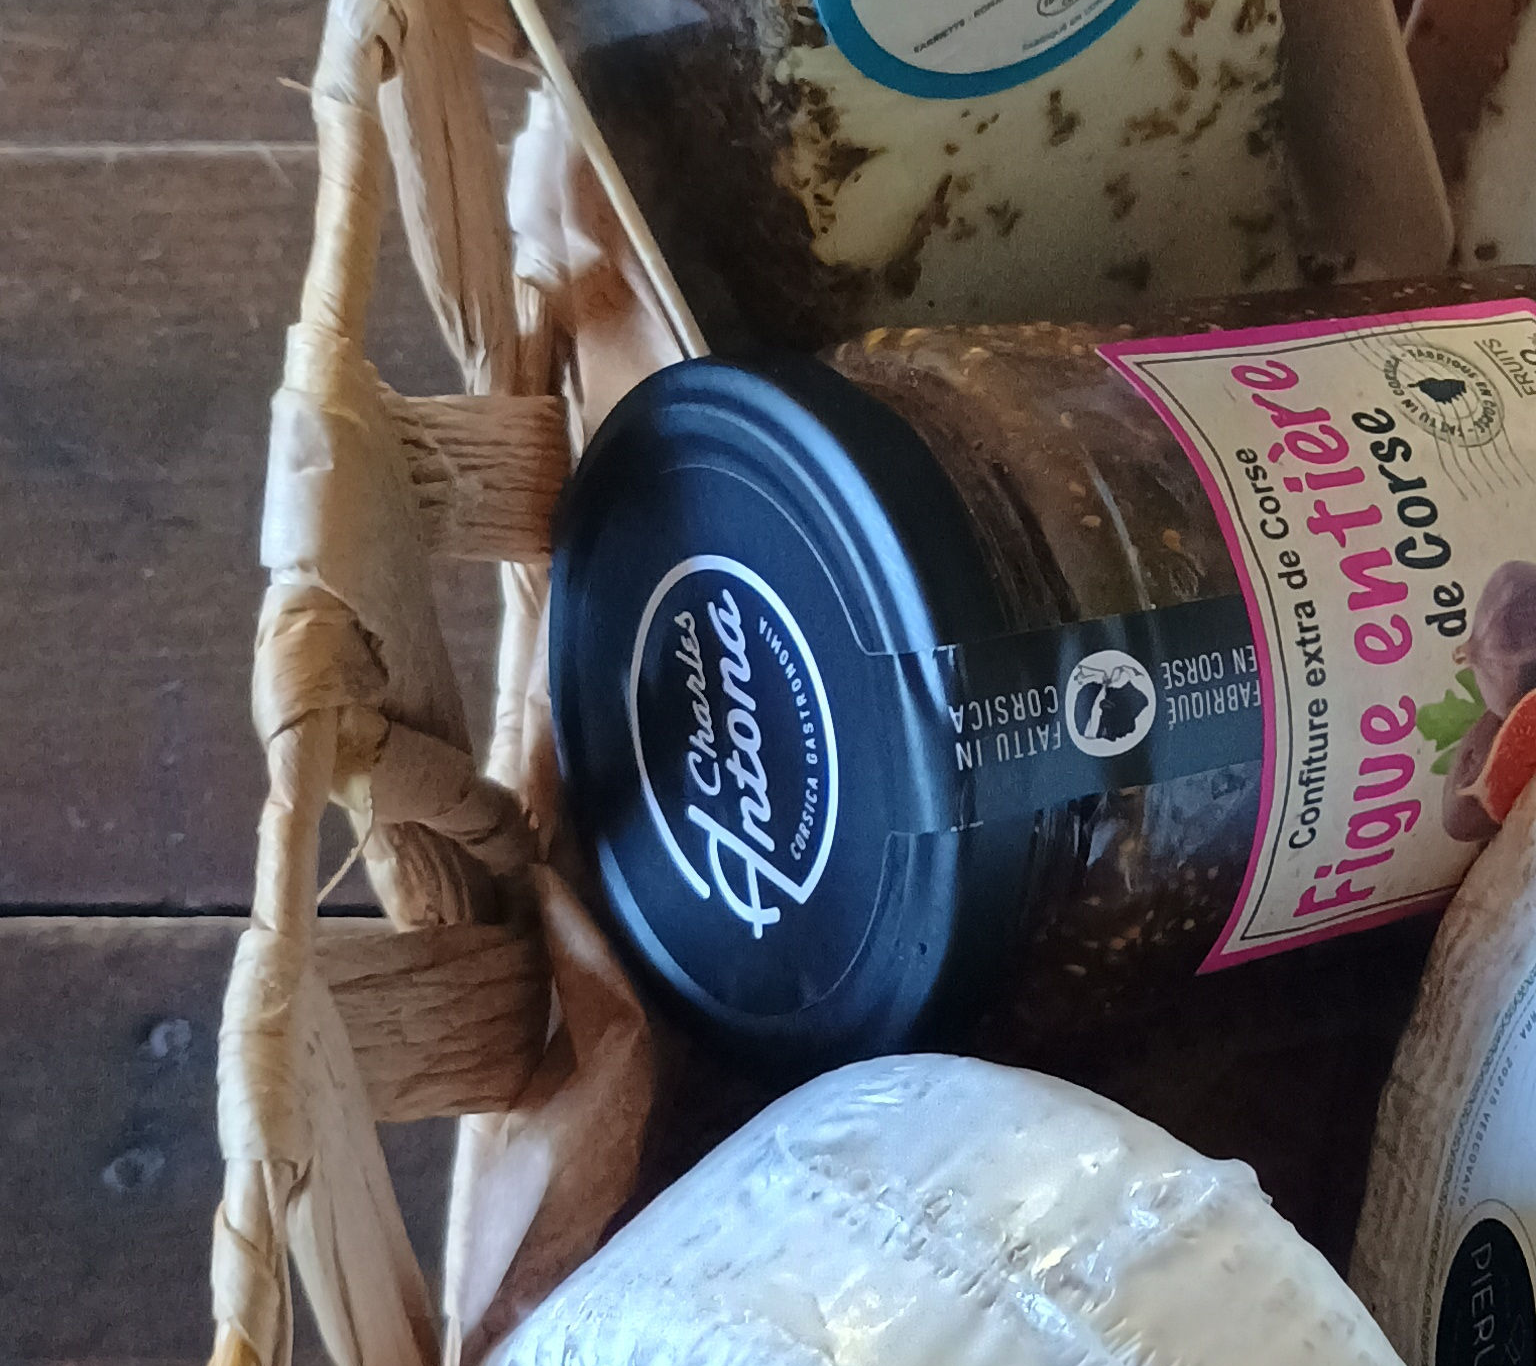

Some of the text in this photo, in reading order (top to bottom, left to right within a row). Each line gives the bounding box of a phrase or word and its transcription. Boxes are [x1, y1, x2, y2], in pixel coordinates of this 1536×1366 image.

[1353, 406, 1466, 638] de Corse
[674, 610, 722, 796] Charles
[759, 615, 819, 862] CORSICA GASTRONOMIA
[946, 684, 1059, 734] CORSICA
[1159, 644, 1258, 690] EN CORSE
[1166, 679, 1262, 732] FABRIQUÉ
[1235, 447, 1328, 849] Confiture extra de Corse
[687, 588, 800, 939] Antona
[954, 721, 1062, 771] FATTU IN
[1294, 696, 1423, 918] Figue
[1458, 1112, 1492, 1207] VESCOVATO
